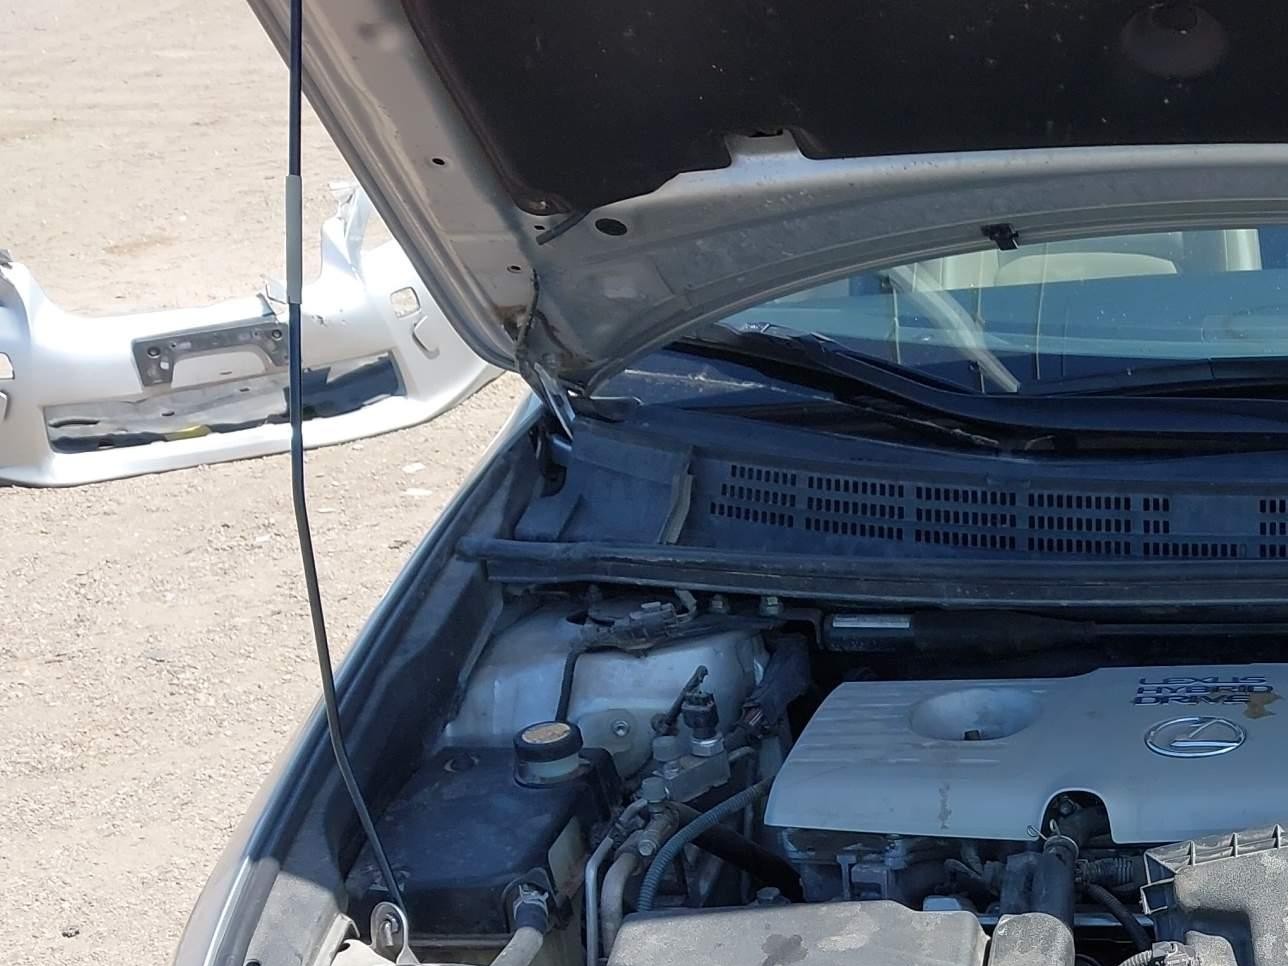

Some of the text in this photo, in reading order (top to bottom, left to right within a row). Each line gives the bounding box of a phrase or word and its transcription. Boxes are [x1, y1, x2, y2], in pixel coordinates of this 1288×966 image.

[1139, 676, 1267, 685] LEXUS
[1136, 685, 1273, 694] HYBRID
[1133, 694, 1251, 705] DRIVE
